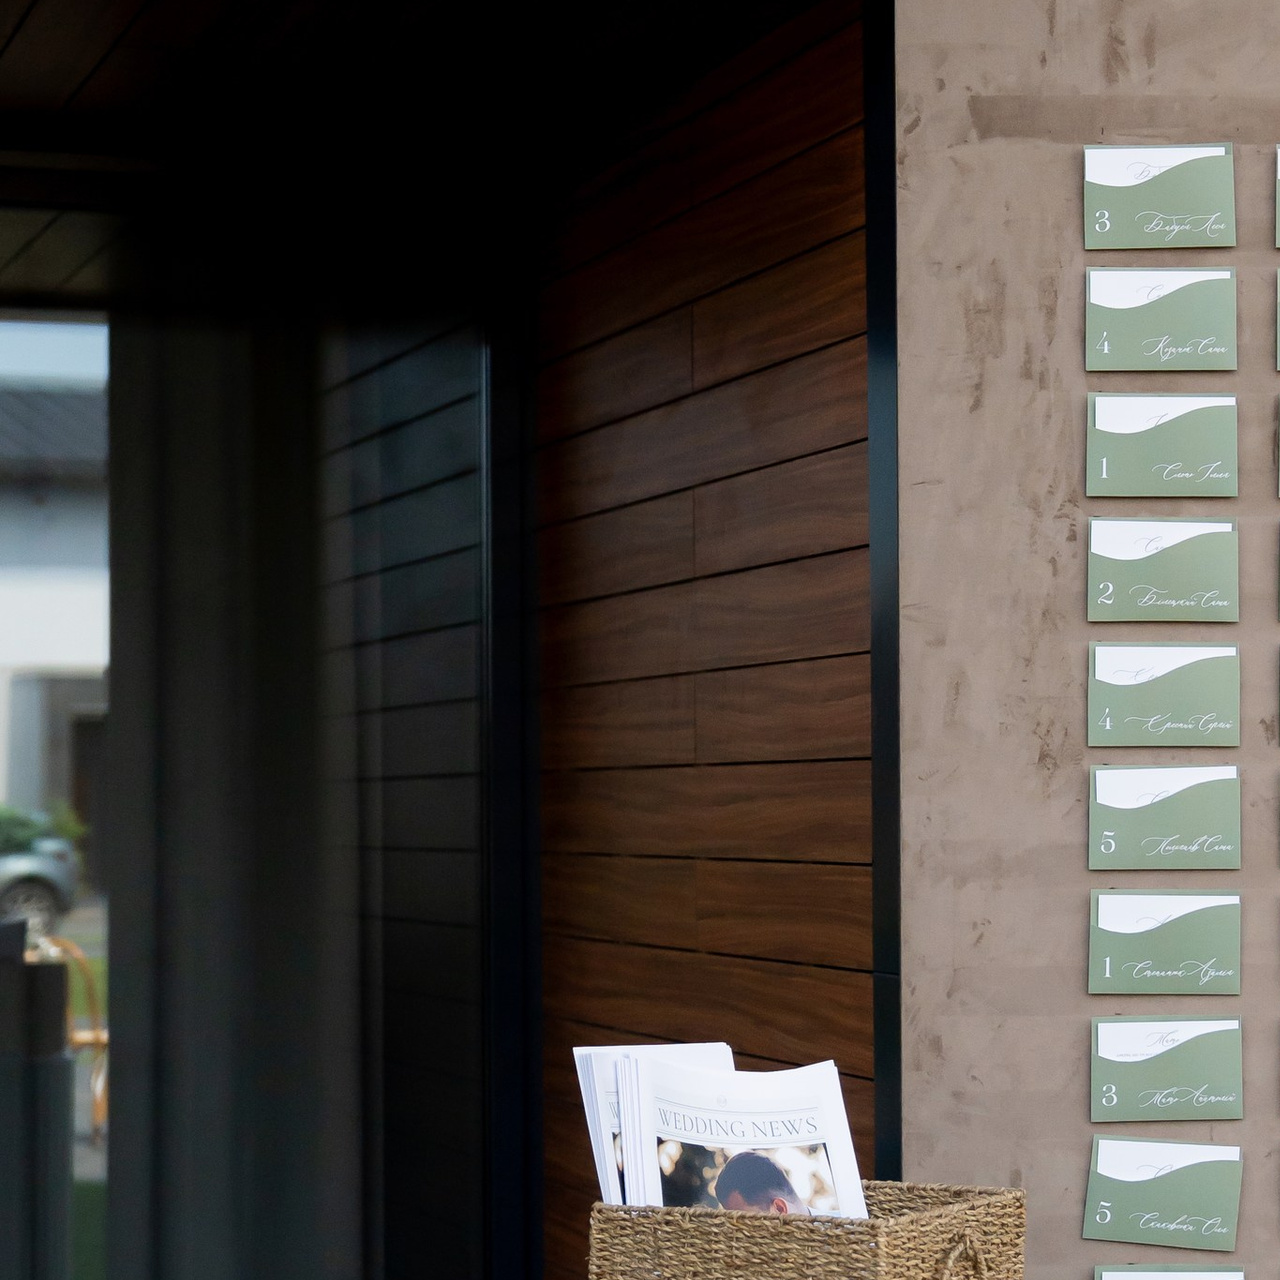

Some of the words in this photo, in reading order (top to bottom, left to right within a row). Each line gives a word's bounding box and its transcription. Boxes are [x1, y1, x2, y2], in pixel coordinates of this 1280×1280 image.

[1095, 210, 1110, 232] 3
[1096, 331, 1111, 354] 4
[1100, 458, 1108, 478] 1
[1098, 582, 1115, 603] 2
[1098, 708, 1113, 730] 4
[1101, 832, 1116, 854] 5
[1103, 956, 1112, 978] 1
[1102, 1084, 1118, 1107] 3
[658, 1107, 746, 1138] WEDDING
[747, 1116, 818, 1138] NEWS
[1096, 1201, 1112, 1224] 5
